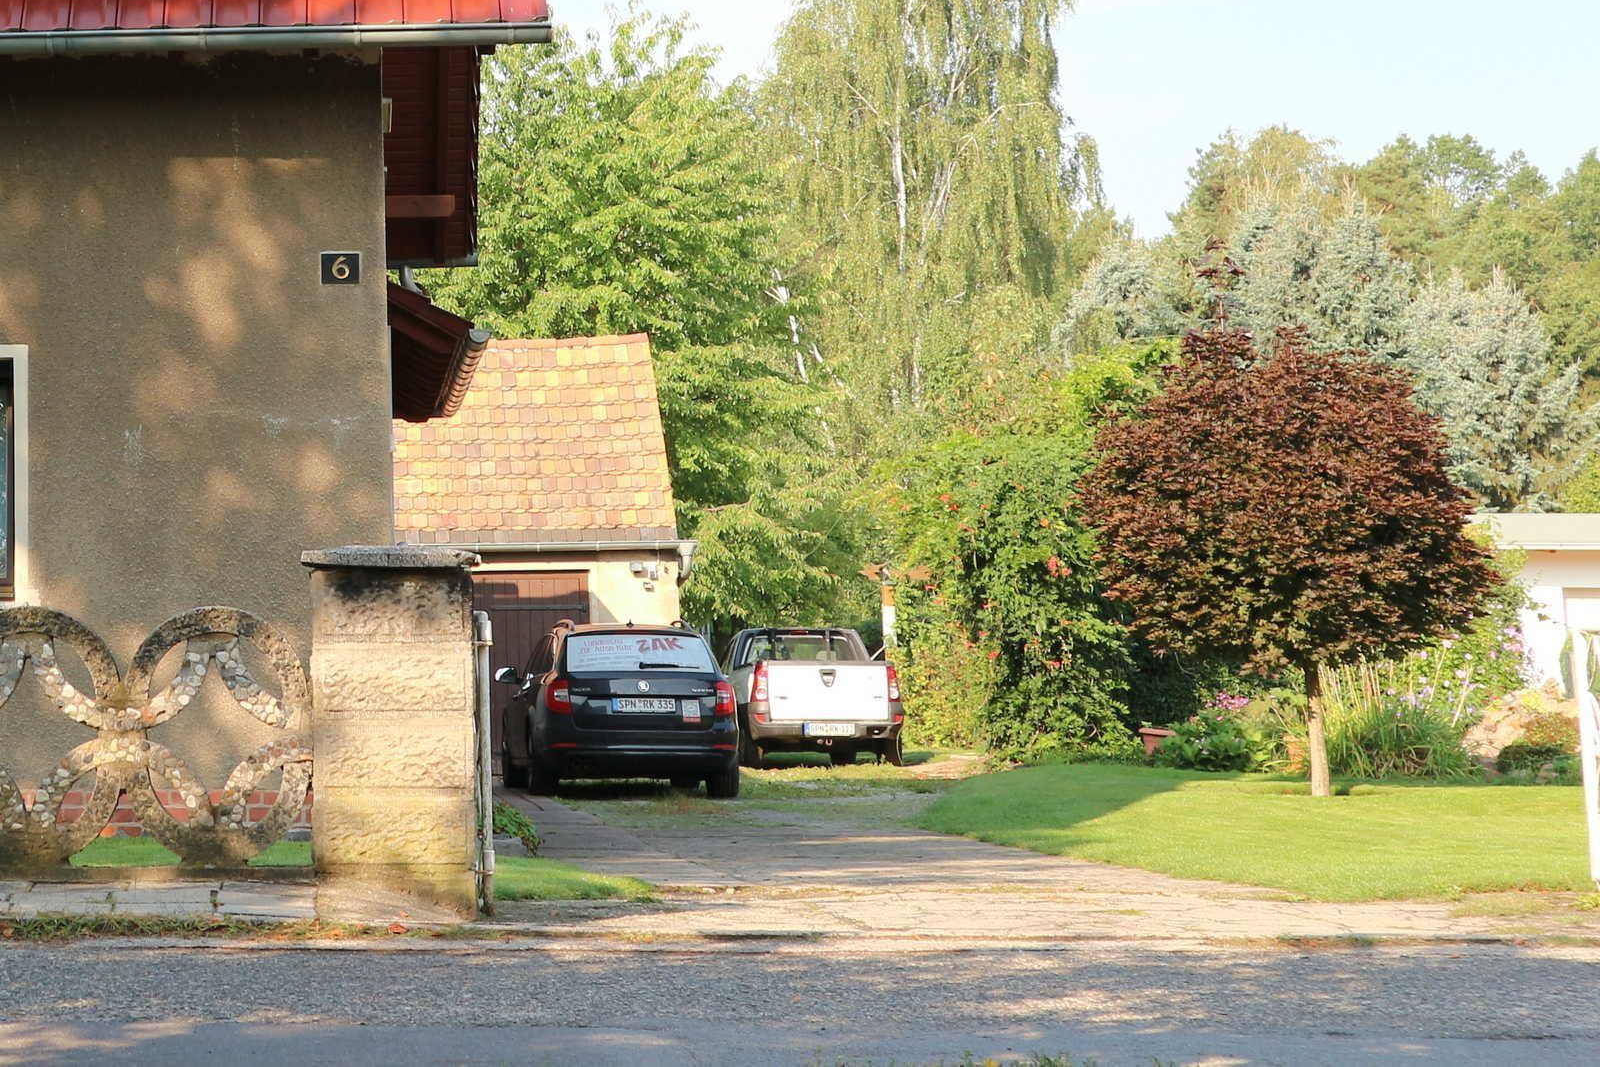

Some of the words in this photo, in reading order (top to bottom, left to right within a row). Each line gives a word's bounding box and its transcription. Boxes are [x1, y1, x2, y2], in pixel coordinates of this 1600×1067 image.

[331, 255, 350, 280] 6
[635, 637, 684, 654] ZAK
[618, 699, 637, 709] SPN
[642, 699, 655, 709] RK
[657, 699, 674, 710] 335
